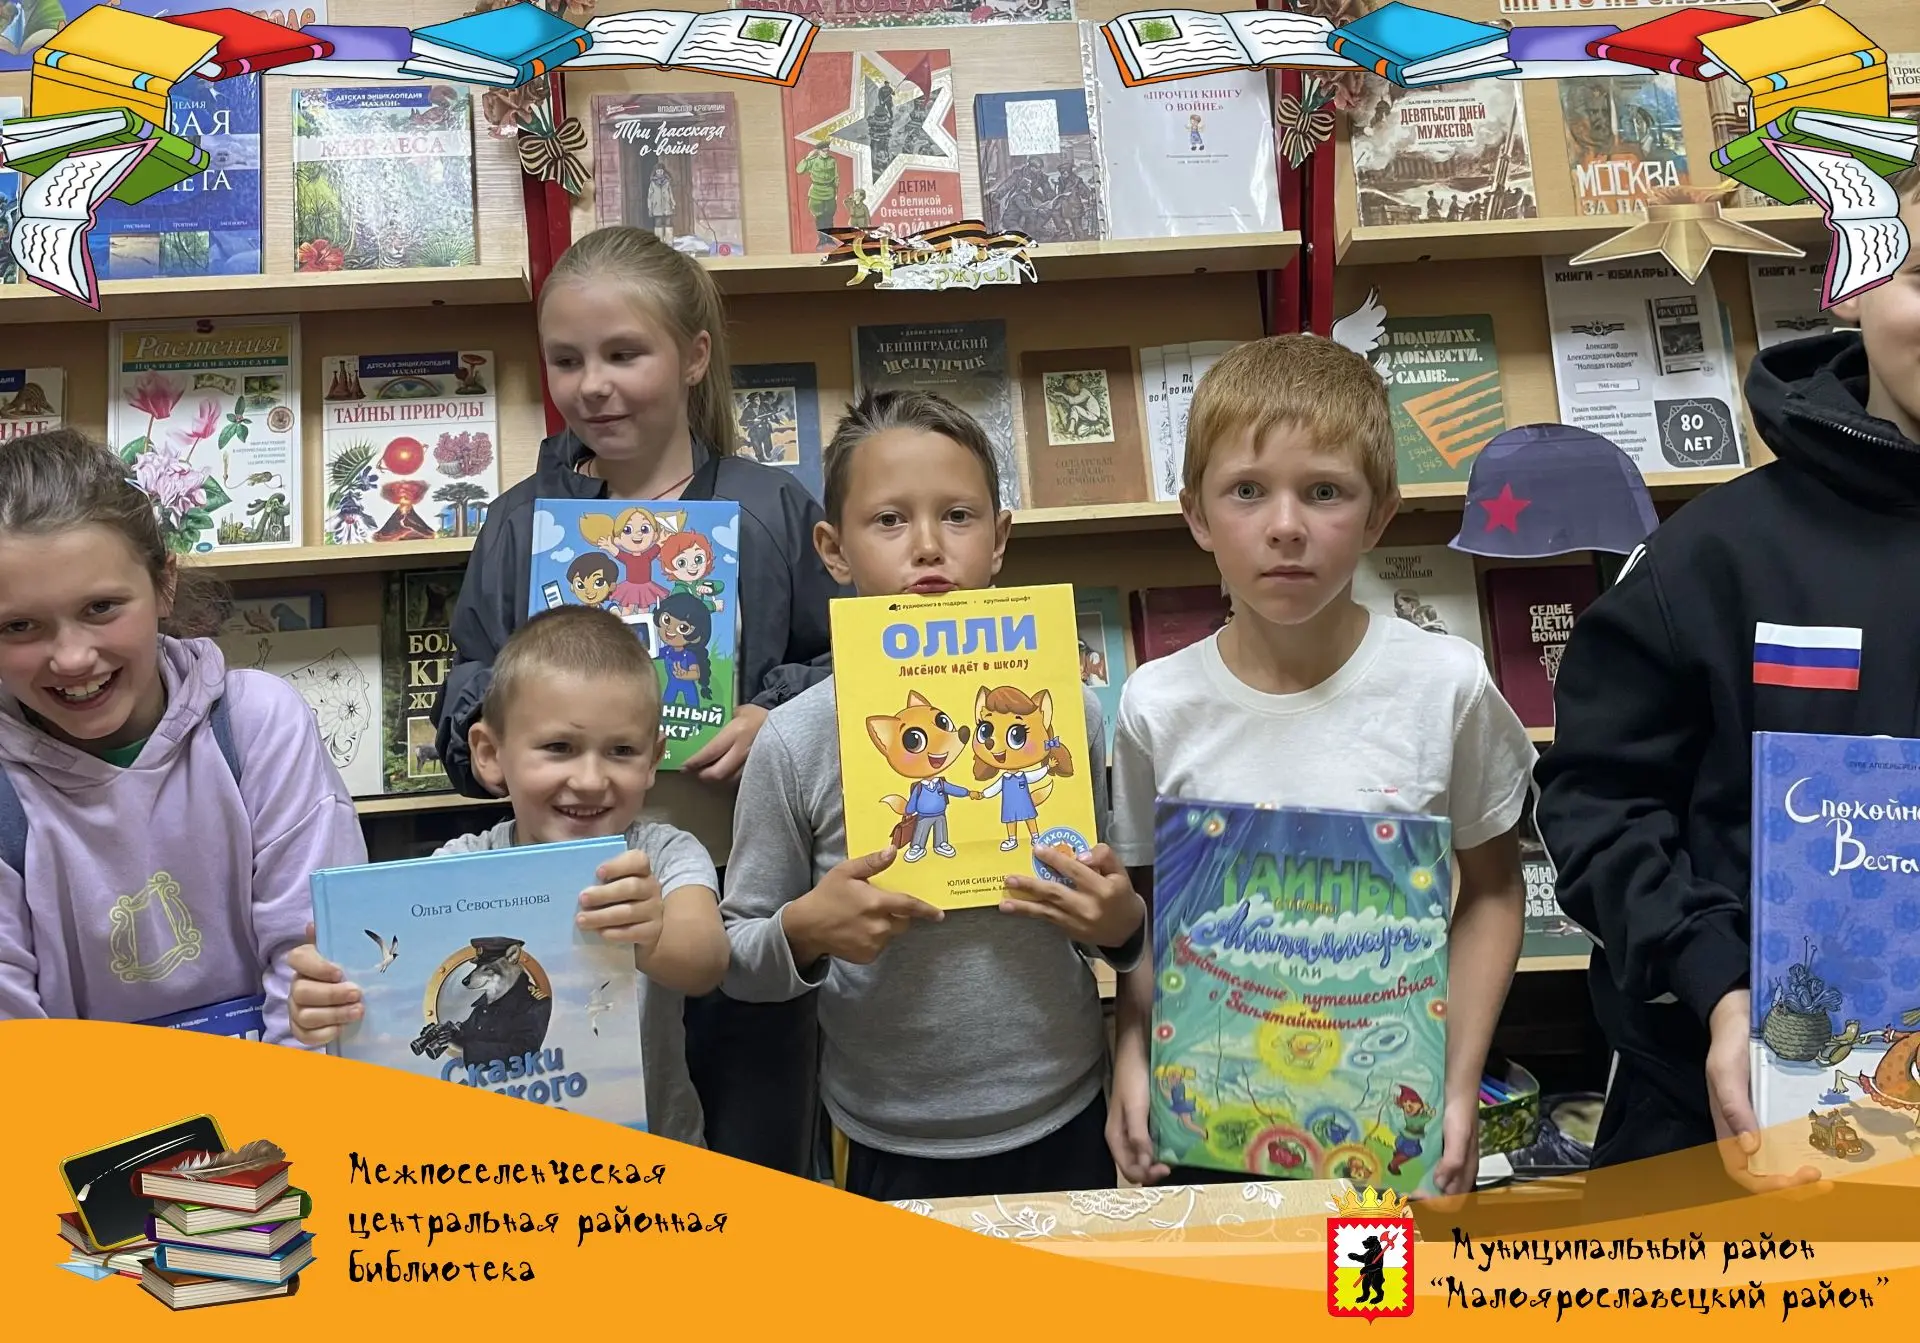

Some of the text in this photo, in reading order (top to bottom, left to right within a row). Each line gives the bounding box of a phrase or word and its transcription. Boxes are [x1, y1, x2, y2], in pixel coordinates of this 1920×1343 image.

[1143, 89, 1242, 100] «ПРОЧТИ КНИГУ
[1165, 101, 1224, 112] О ВОЙНЕ»
[1400, 102, 1486, 125] ДЕВЯТЬСОТ ДНЕЙ
[612, 119, 726, 144] Три рассказа
[1416, 122, 1474, 140] МУЖЕСТВА
[320, 136, 446, 158] МИР ЛЕСА
[639, 137, 699, 157] о войне
[898, 180, 937, 195] ДЕТЯМ
[1576, 160, 1681, 197] МОСКВА
[899, 195, 941, 207] Великой
[1583, 200, 1611, 215] ЗА
[880, 205, 954, 218] Отечественной
[846, 234, 895, 288] Я
[1555, 268, 1669, 282] КНИГИ ЮБИЛЯРЫ
[1758, 266, 1790, 277] КНИГИ
[135, 334, 282, 360] Растения
[876, 336, 988, 353] ЛЕНИНГРАДСКИЙ
[1392, 328, 1481, 348] ПОДВИГАХ.
[366, 359, 451, 370] ДЕТСКАЯ ЭНЦИКЛОПЕДИЯ
[882, 355, 987, 375] Щелкунчик
[1392, 348, 1483, 369] ДОБЛЕСТИ.
[1396, 368, 1460, 384] СЛАВЕ...
[334, 401, 484, 424] ТАЙНЫ ПРИРОДЫ
[1680, 414, 1704, 432] 80
[1684, 436, 1713, 452] ЛЕТ
[1529, 603, 1573, 617] СЕДЫЕ
[1531, 615, 1574, 632] ДЕТИ
[882, 614, 1038, 660] ОЛЛИ
[898, 658, 1029, 677] Лисёнок идёт в школу
[662, 705, 723, 725] нный
[1043, 831, 1085, 853] ИХОЛОГИ
[1825, 817, 1920, 877] Веста
[947, 878, 971, 887] ЮЛИЯ
[411, 893, 551, 918] Ольга Севостьянова
[1288, 965, 1322, 979] ИЛИ
[1302, 975, 1437, 1013] путешествия
[440, 1047, 565, 1088] Сказки
